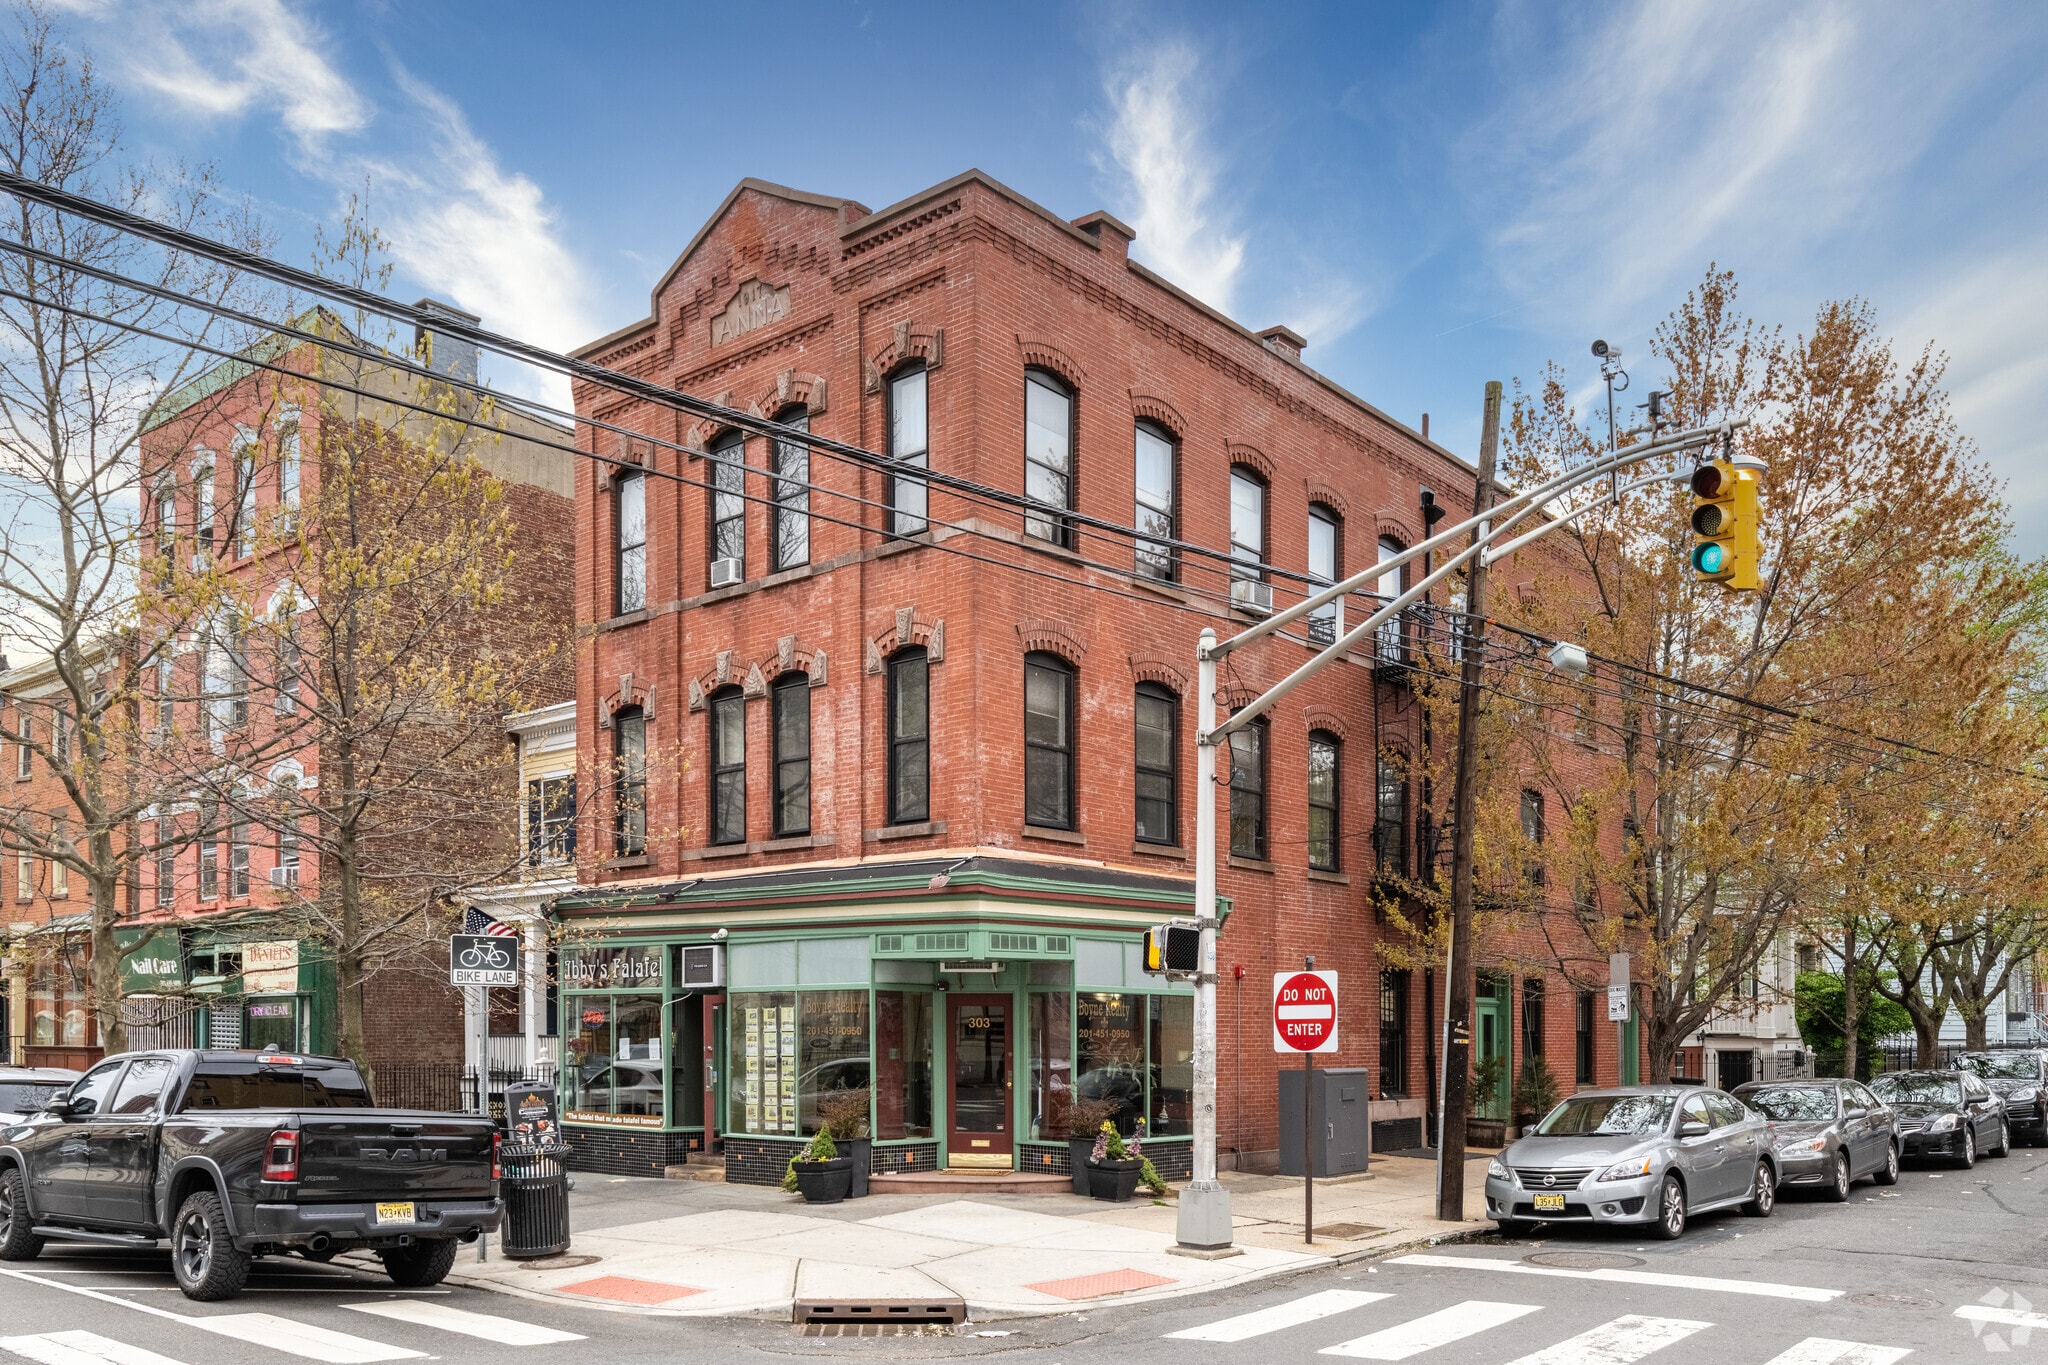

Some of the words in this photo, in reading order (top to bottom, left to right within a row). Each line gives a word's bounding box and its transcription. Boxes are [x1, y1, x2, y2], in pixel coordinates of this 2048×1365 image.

[718, 295, 784, 344] ANNA
[131, 957, 152, 974] Nail
[153, 957, 178, 974] Care
[564, 958, 608, 983] Ibby's
[612, 956, 663, 978] Falafel
[456, 970, 481, 982] BIKE
[485, 971, 513, 983] LANE
[1283, 989, 1299, 1002] DO
[1305, 988, 1327, 1001] NOT
[250, 1006, 264, 1016] DRY
[805, 997, 832, 1018] Boyne
[834, 996, 863, 1018] Realty
[1078, 999, 1104, 1021] Boyne
[1105, 1000, 1130, 1022] Realty
[968, 1017, 991, 1029] 303
[1287, 1023, 1322, 1036] ENTER
[806, 1026, 862, 1036] 201-451-0950
[1079, 1029, 1130, 1039] 201-451-0950
[360, 1148, 447, 1161] RAM
